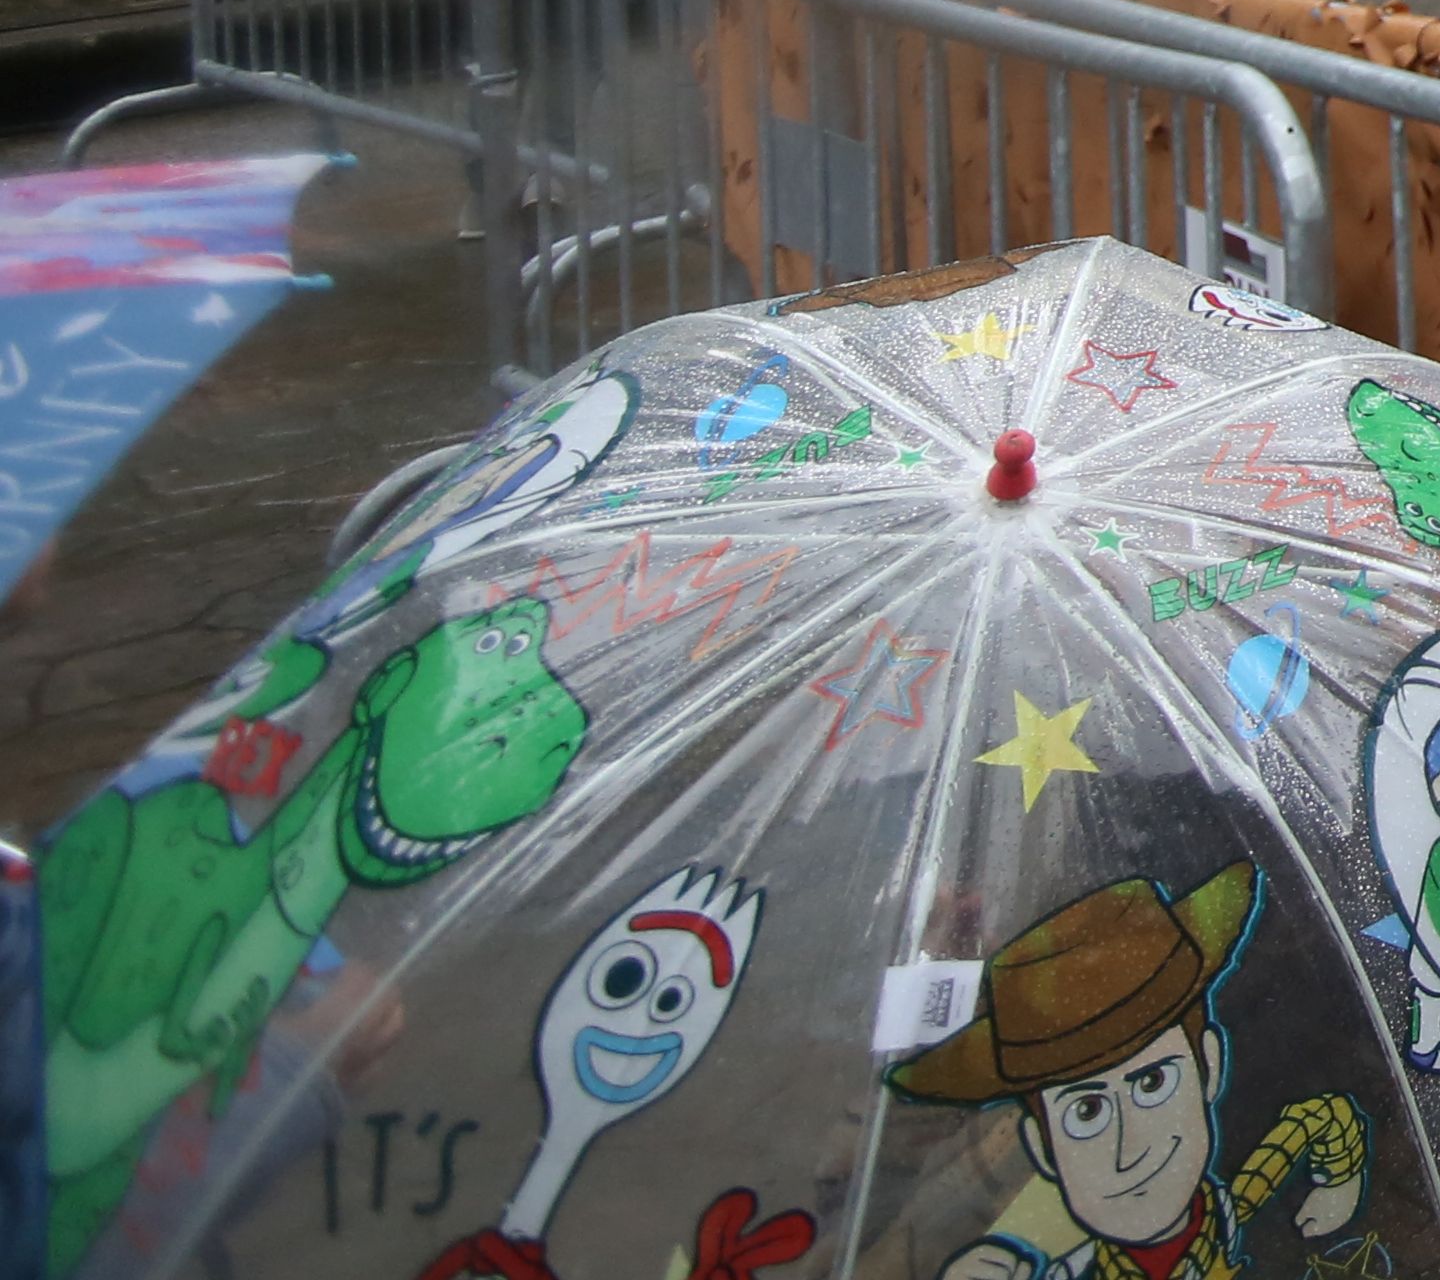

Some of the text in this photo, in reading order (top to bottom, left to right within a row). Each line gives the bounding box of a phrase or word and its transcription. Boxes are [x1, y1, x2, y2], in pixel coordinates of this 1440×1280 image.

[1148, 542, 1299, 623] BUZZ
[203, 713, 304, 798] REX
[321, 1096, 481, 1234] IT'S
